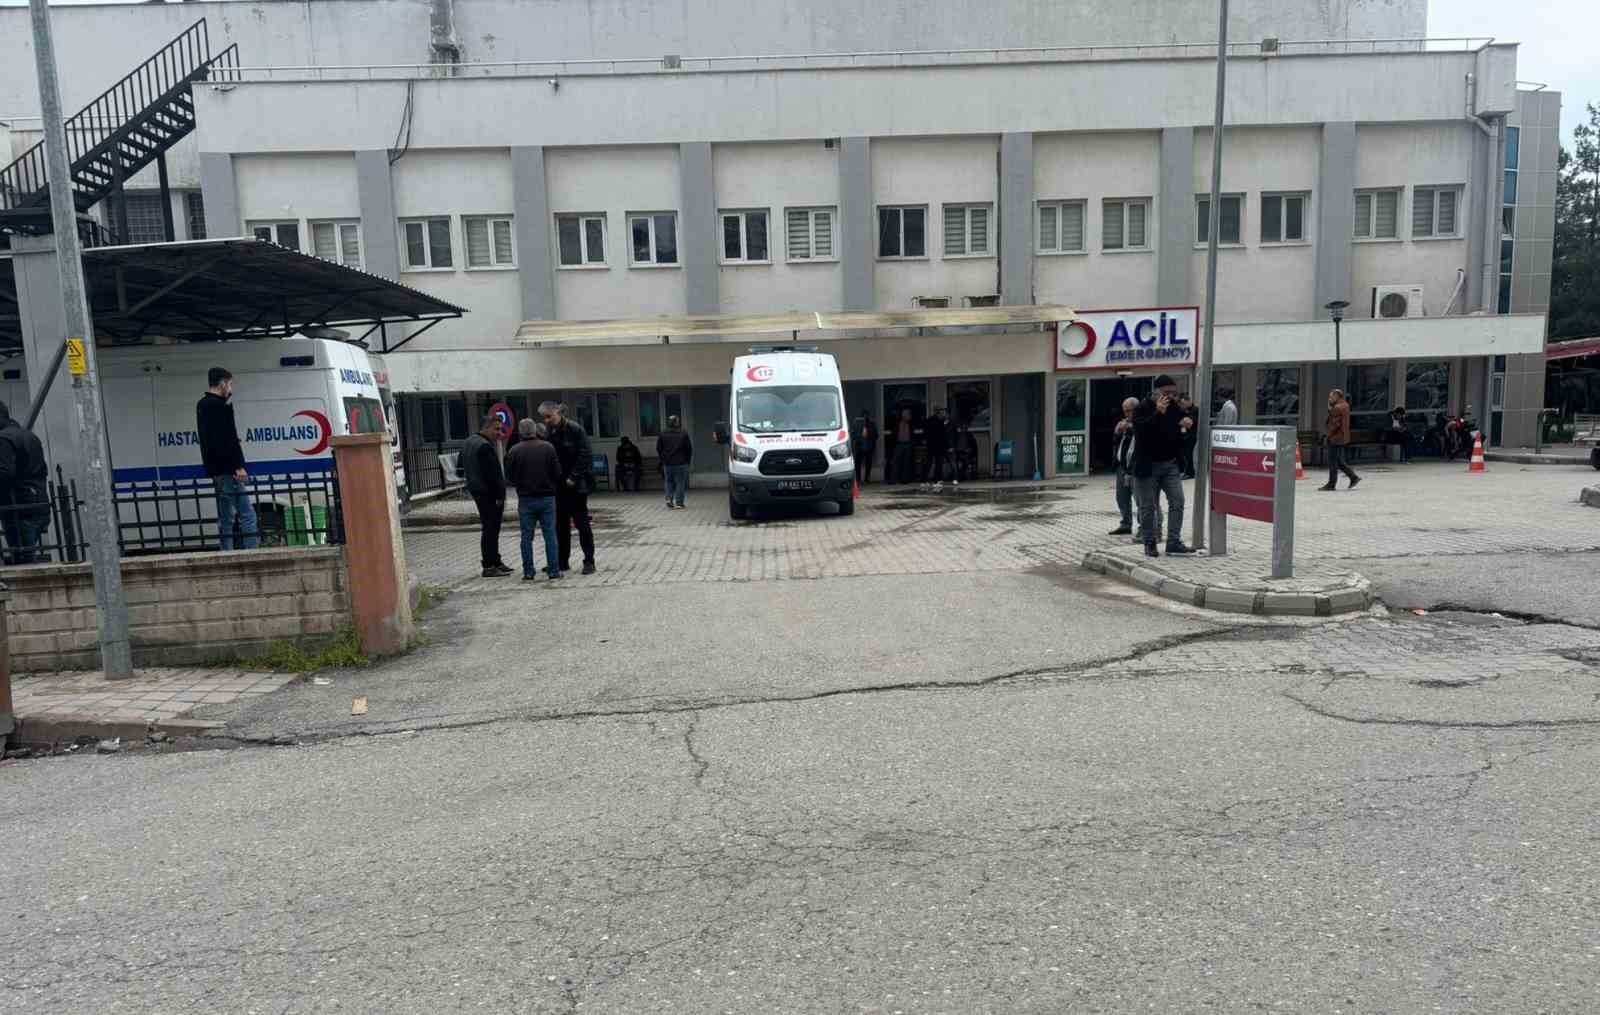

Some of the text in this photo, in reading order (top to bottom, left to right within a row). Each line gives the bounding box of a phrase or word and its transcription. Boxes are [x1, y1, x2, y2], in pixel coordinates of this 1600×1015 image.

[1106, 312, 1189, 348] ACİL
[1105, 347, 1191, 362] (EMERGENCY)
[158, 431, 200, 446] HASTA
